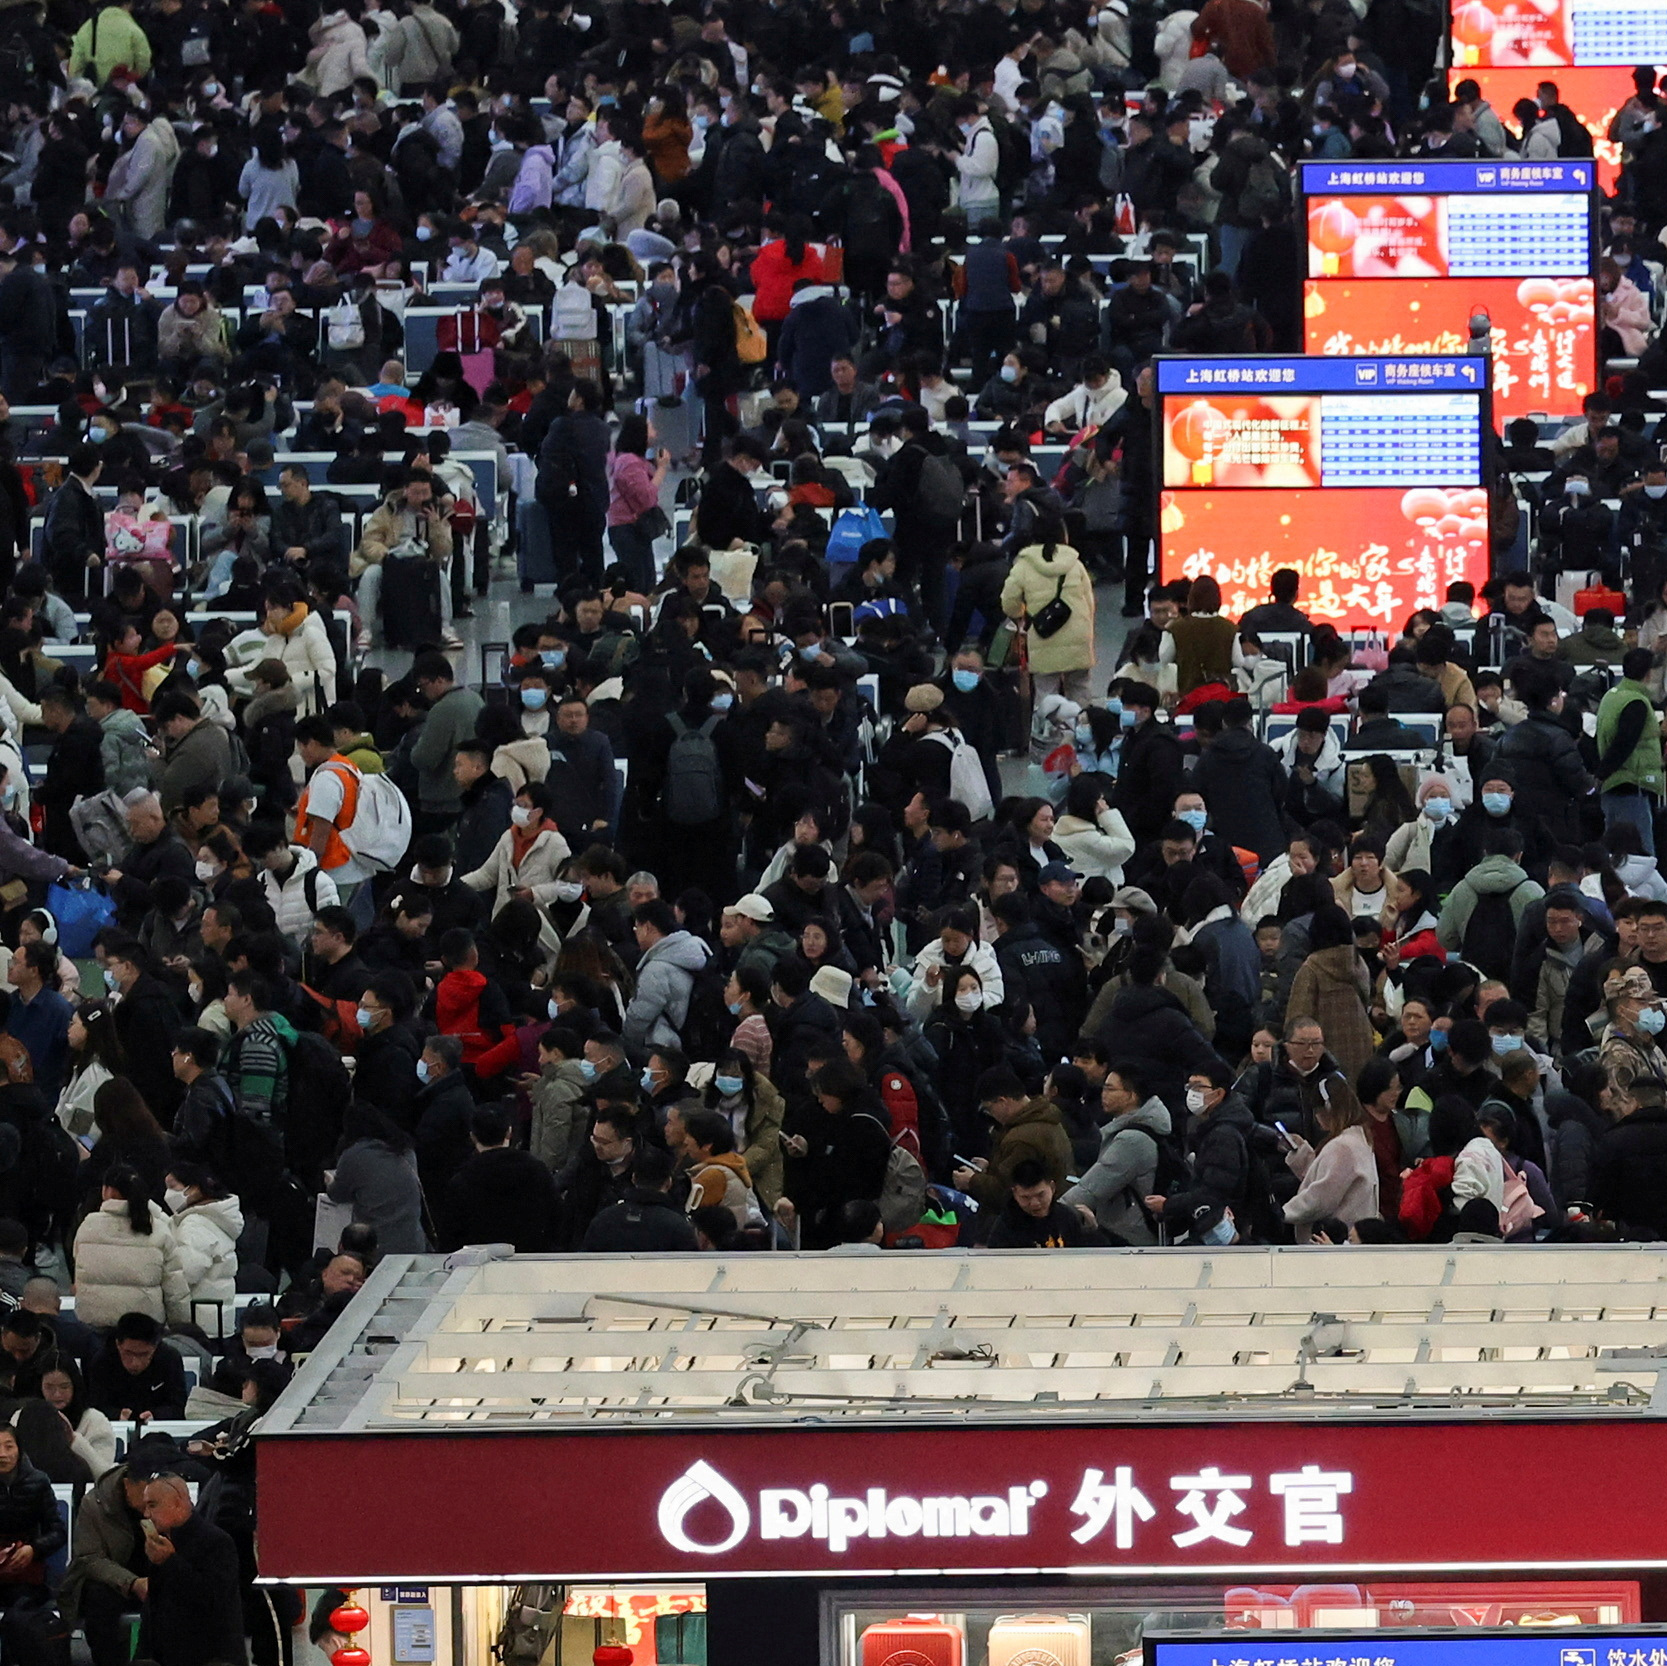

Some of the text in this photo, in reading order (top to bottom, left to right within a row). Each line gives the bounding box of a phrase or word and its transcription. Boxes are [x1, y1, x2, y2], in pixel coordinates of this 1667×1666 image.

[1186, 369, 1295, 383] 上海虹桥站欢迎您
[1358, 368, 1376, 380] VIP
[760, 1466, 1352, 1552] Diplomat 外交官
